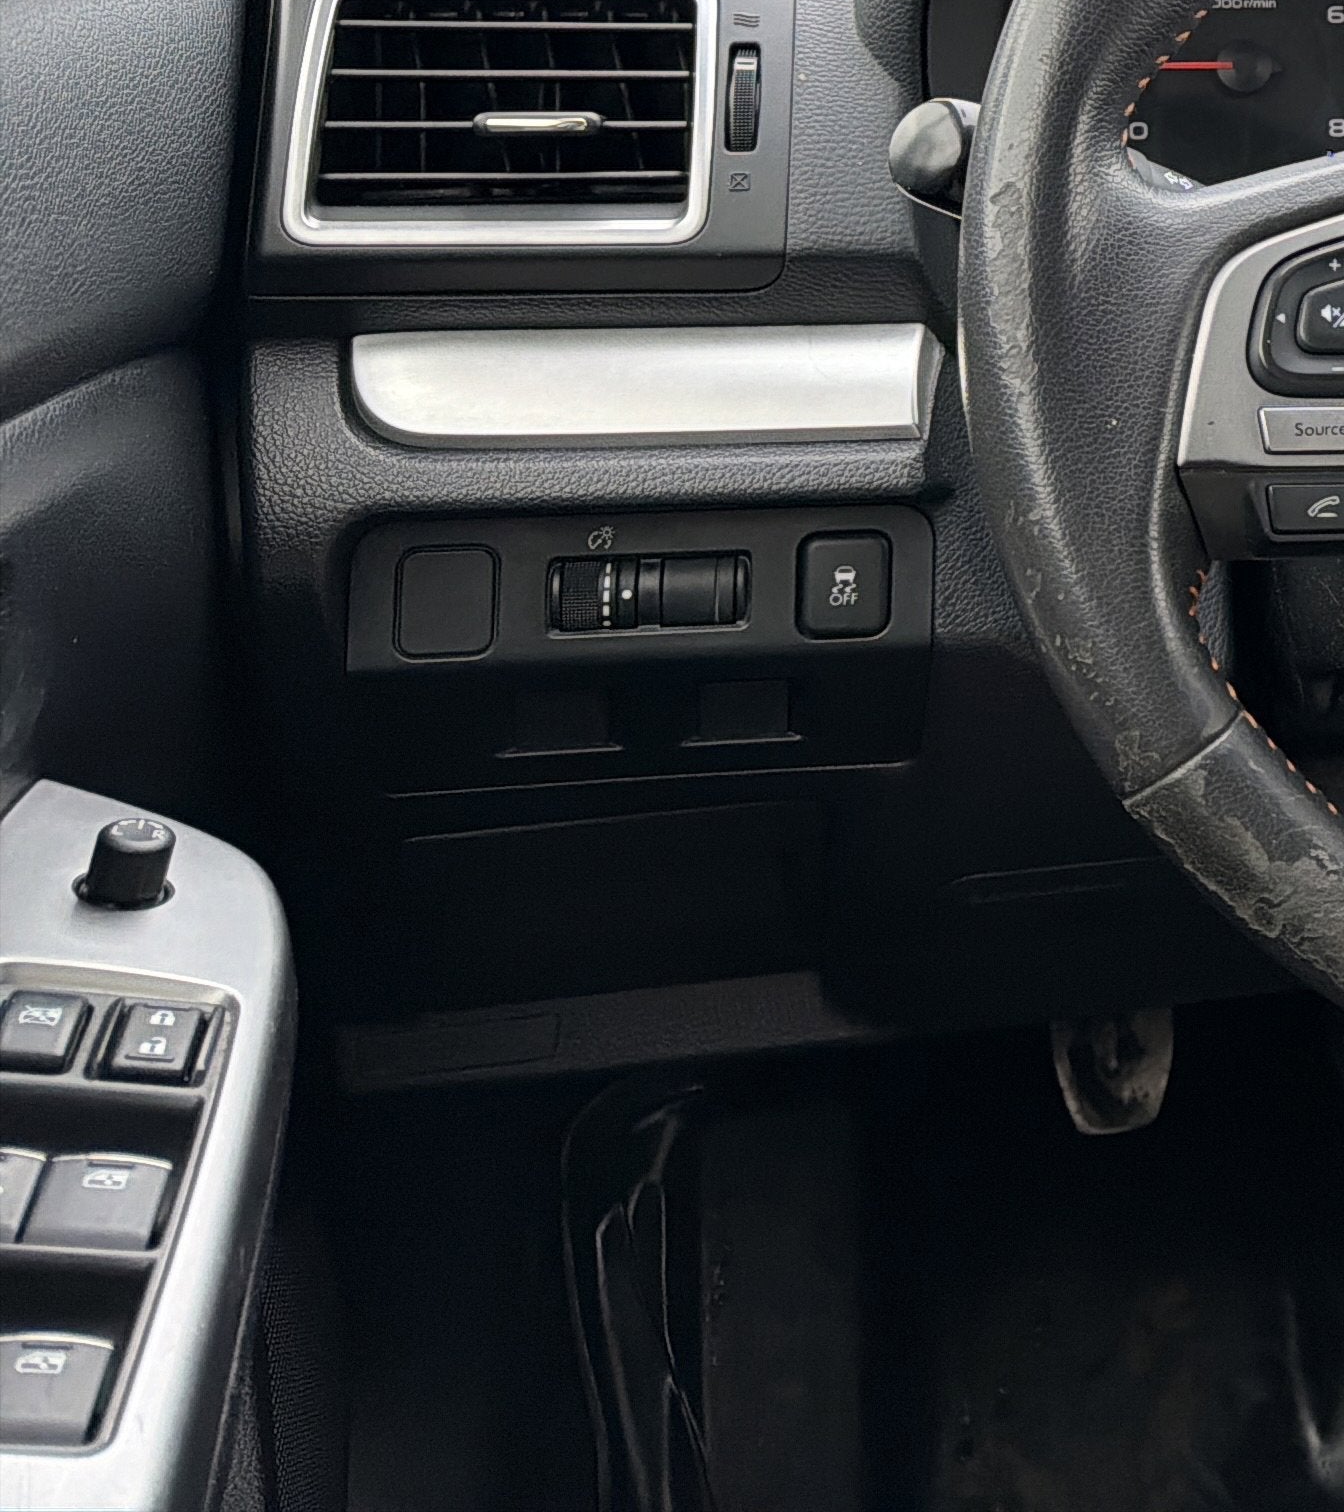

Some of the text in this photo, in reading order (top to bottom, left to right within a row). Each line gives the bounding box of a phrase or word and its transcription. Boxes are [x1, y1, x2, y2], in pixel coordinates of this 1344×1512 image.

[1326, 5, 1344, 24] 6
[1128, 121, 1149, 140] 0
[828, 590, 859, 607] OFF
